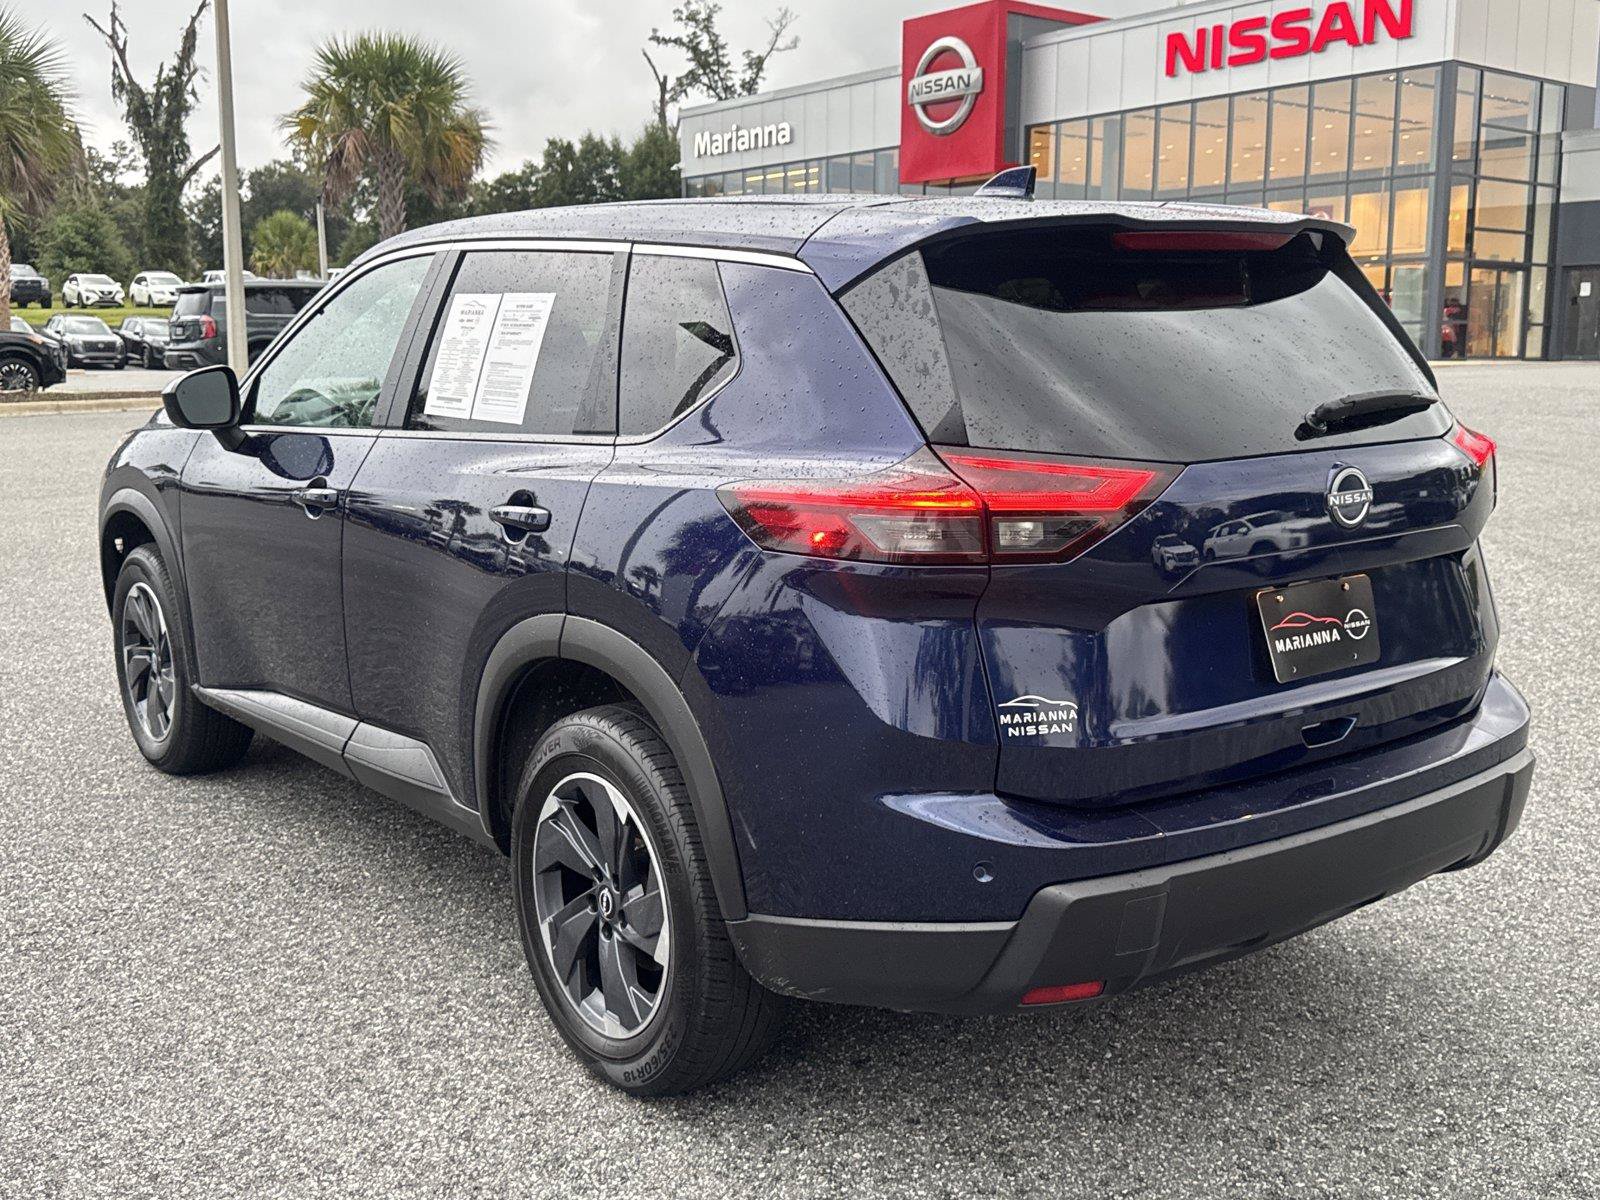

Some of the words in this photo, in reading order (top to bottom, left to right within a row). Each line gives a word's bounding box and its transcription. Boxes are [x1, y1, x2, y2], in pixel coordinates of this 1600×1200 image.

[1166, 0, 1412, 77] NISSAN
[911, 74, 971, 98] NISSAN
[694, 121, 791, 158] Marianna
[1330, 491, 1373, 506] NISSAN
[1344, 619, 1371, 629] NISSAN
[1275, 628, 1341, 653] MARIANNA
[1000, 709, 1078, 724] MARIANNA
[1008, 722, 1073, 737] NISSAN
